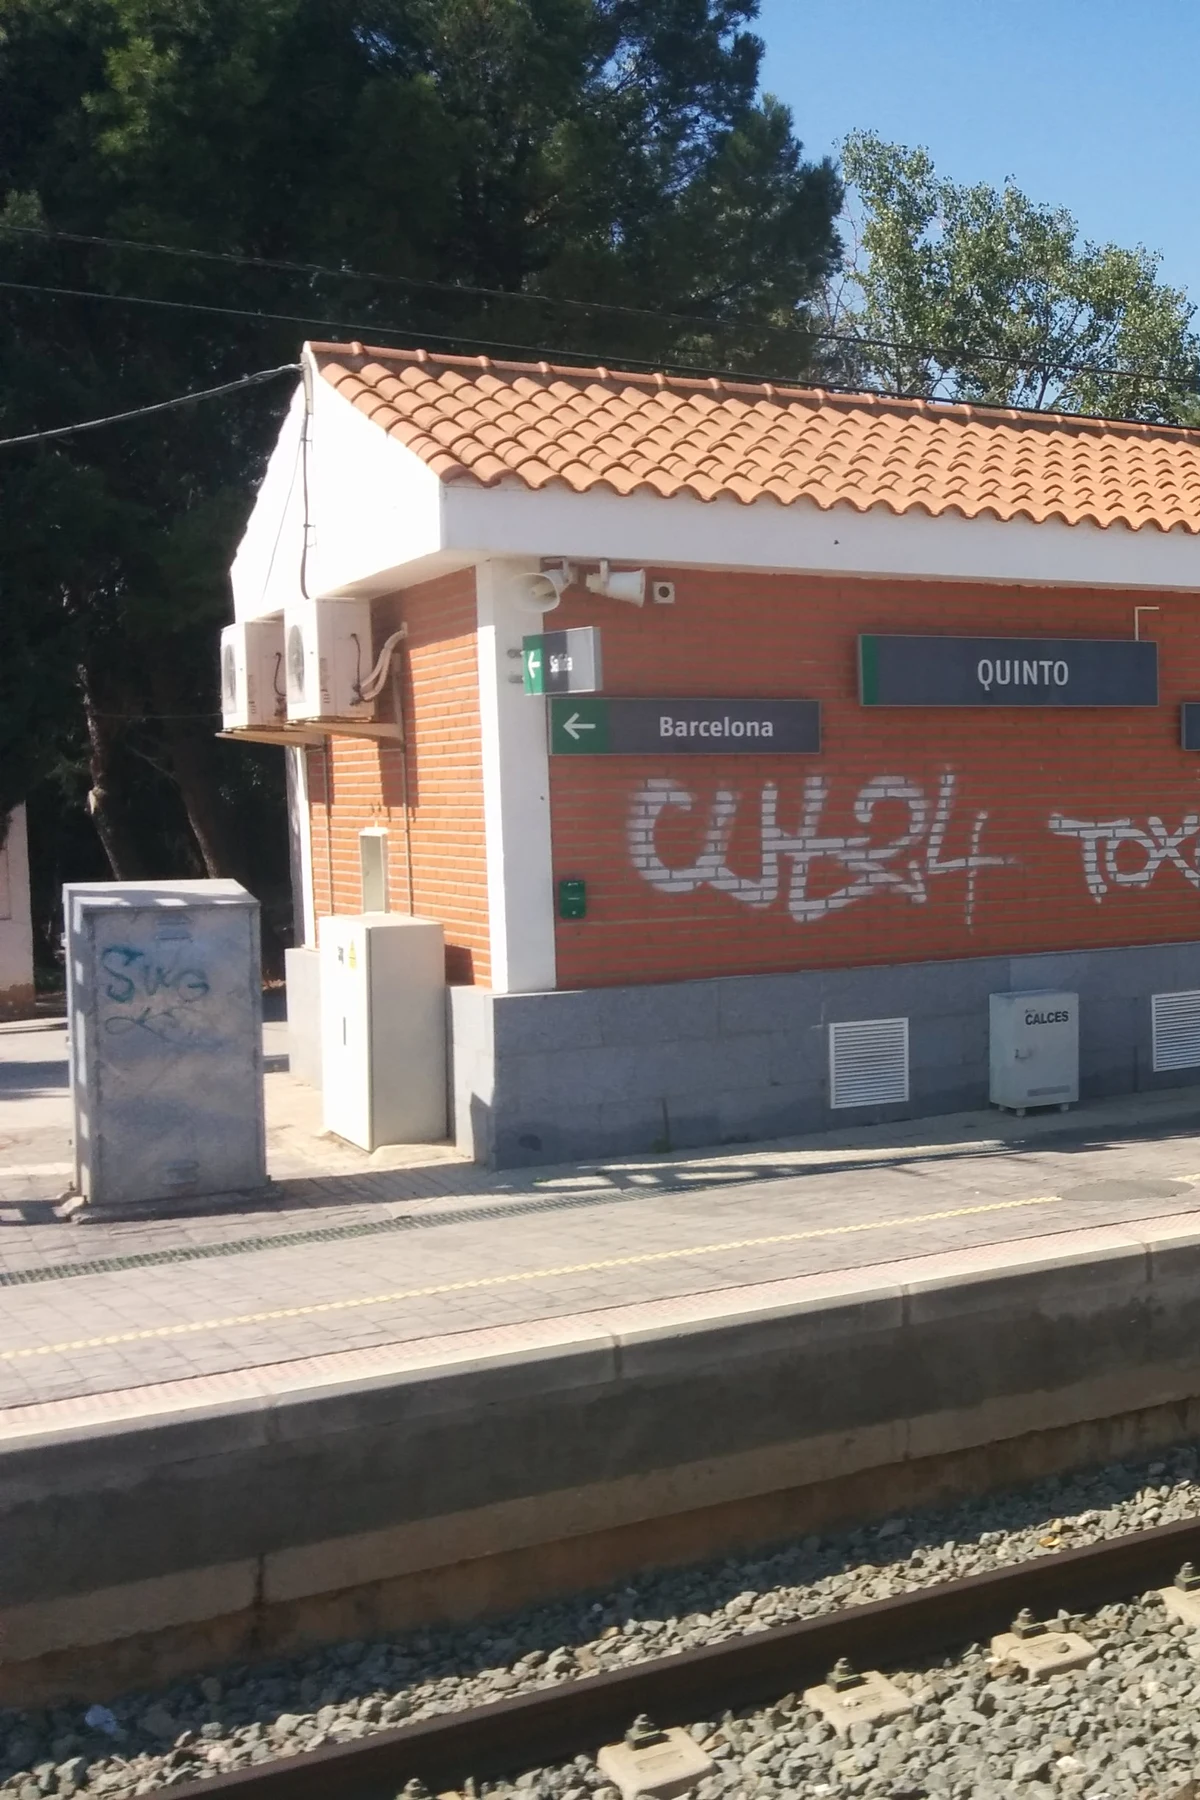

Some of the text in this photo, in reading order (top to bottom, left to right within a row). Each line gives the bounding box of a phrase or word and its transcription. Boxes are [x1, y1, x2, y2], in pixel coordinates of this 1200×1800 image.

[977, 659, 1070, 691] QUINTO
[659, 716, 775, 738] Barcelona
[1025, 1010, 1069, 1025] CALCES
